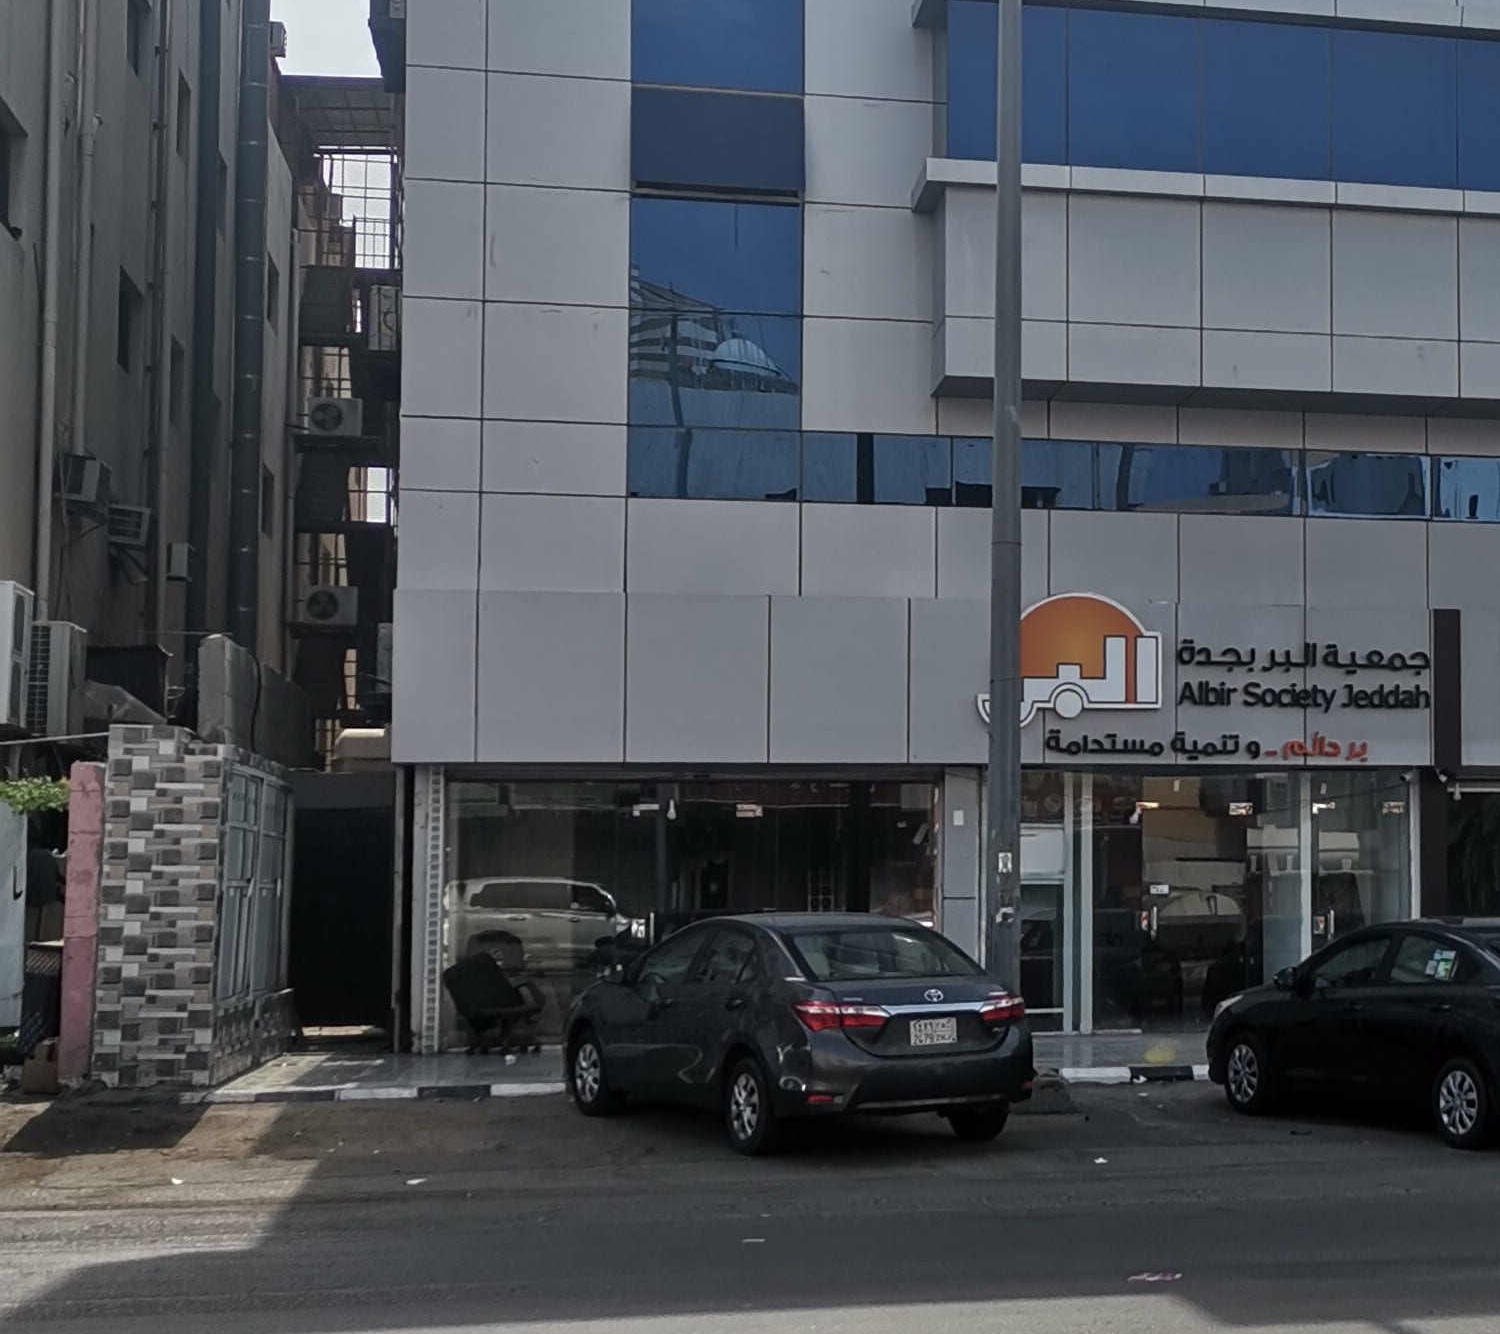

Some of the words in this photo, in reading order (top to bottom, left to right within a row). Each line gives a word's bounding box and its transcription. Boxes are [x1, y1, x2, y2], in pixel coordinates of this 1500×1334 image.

[1177, 639, 1256, 673] بجدة
[1262, 642, 1317, 673] البر
[1322, 643, 1431, 676] جمعية
[1177, 681, 1239, 707] Albir
[1242, 681, 1338, 714] Society
[1340, 683, 1431, 709] Jeddah
[1045, 728, 1164, 757] مستدامة
[1283, 730, 1341, 761] دائم
[1345, 741, 1368, 763] بر
